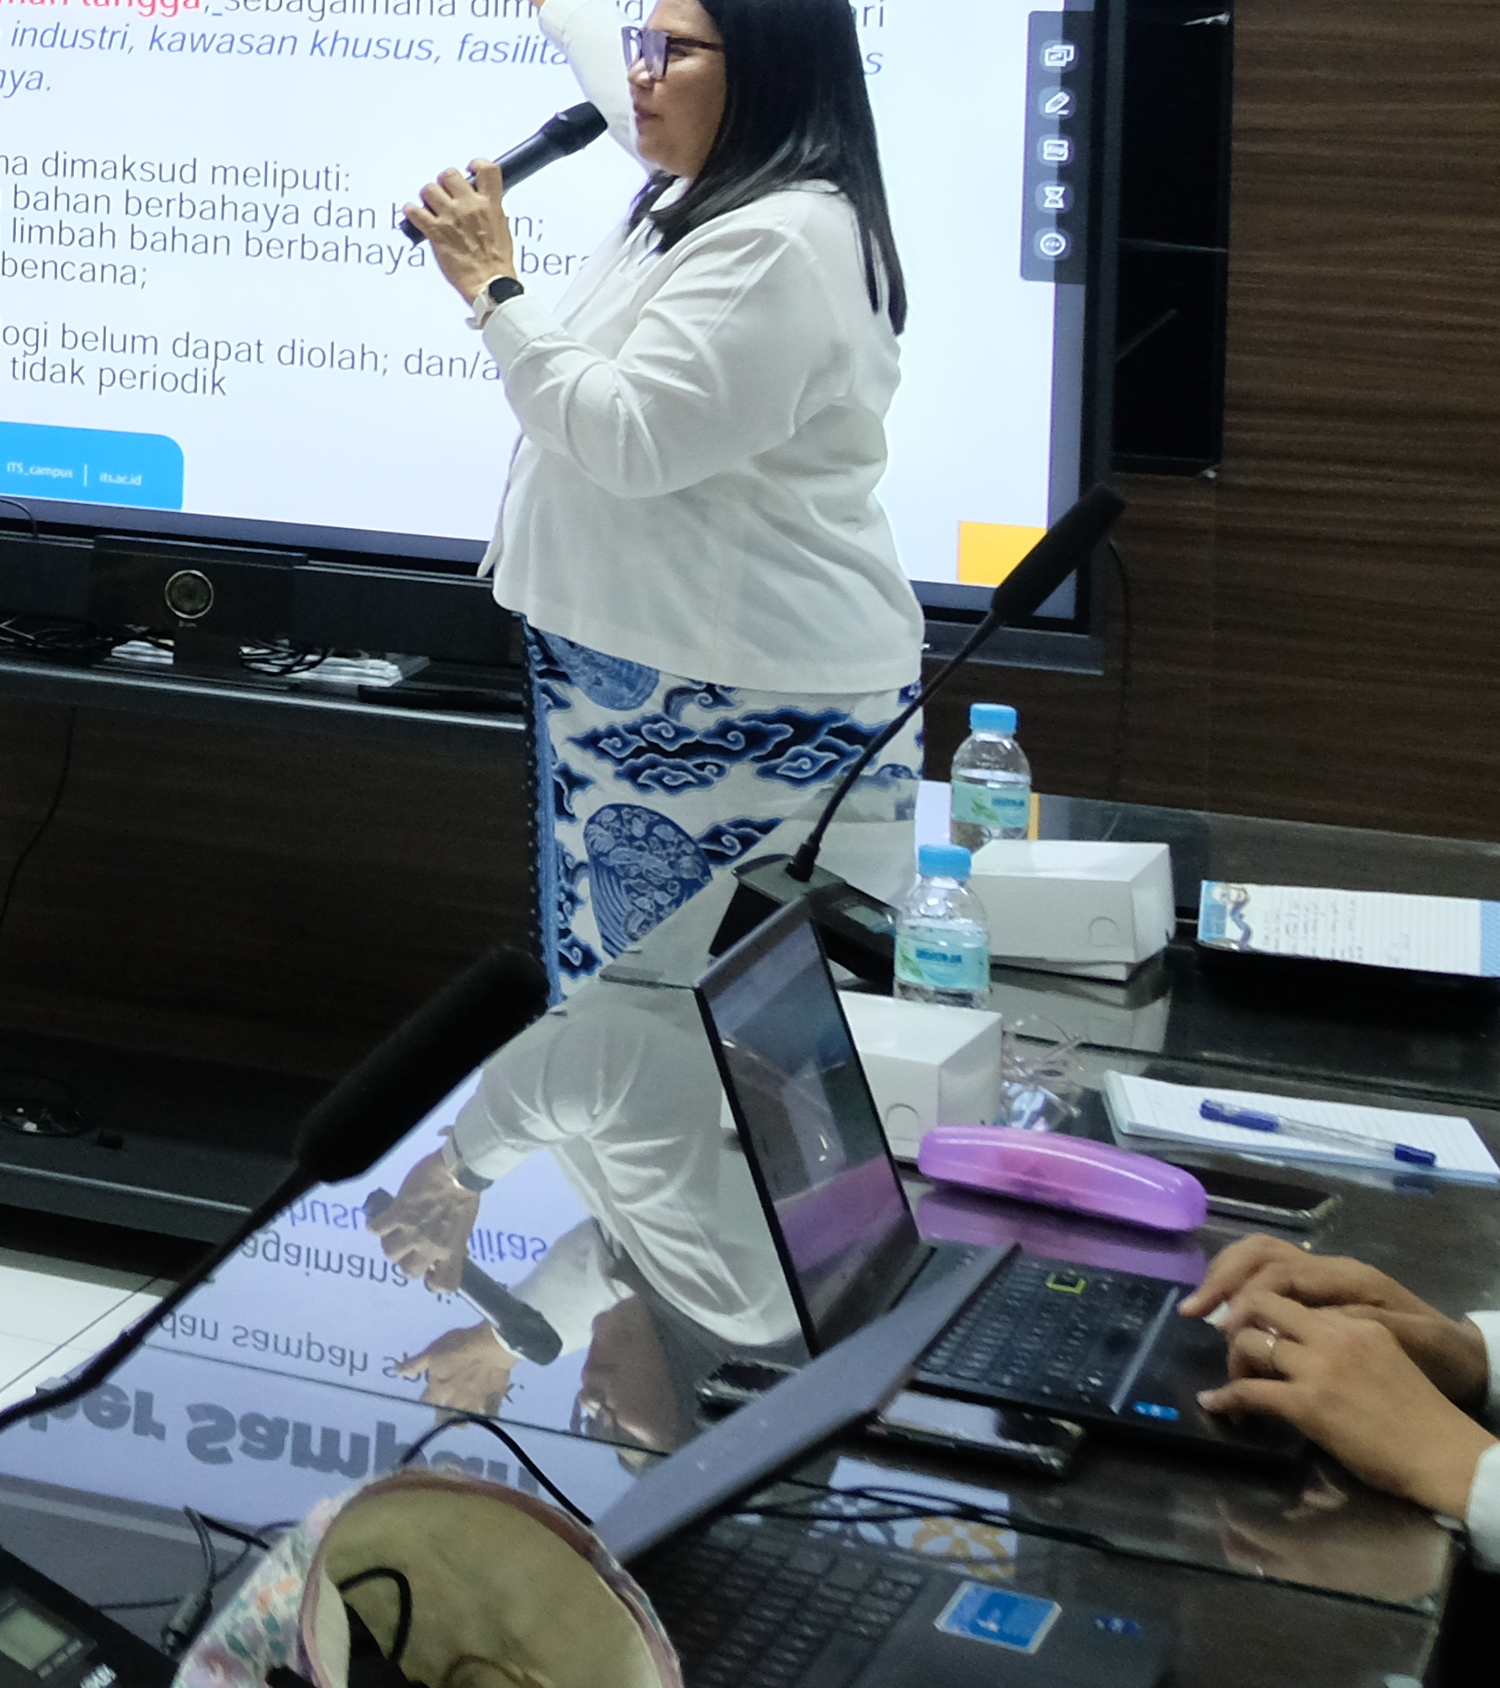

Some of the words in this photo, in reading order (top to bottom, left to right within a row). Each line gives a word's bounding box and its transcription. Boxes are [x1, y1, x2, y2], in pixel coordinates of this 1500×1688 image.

[10, 20, 134, 54] industri,
[148, 24, 297, 56] kawasan
[310, 29, 442, 63] khusus,
[456, 32, 568, 65] fasilita
[41, 151, 197, 184] dimaksud
[211, 161, 350, 198] meliputi:
[13, 183, 110, 214] bahan
[125, 189, 299, 233] berbahaya
[313, 199, 377, 229] dan
[2, 250, 148, 289] bencana;
[11, 217, 116, 249] limbah
[130, 223, 231, 256] bahan
[245, 230, 425, 275] berbahaya
[61, 323, 158, 355] belum
[172, 331, 265, 371] dapat
[278, 339, 389, 376] diolah;
[404, 347, 501, 381] dan/a
[10, 356, 85, 385] tidak
[98, 362, 227, 397] periodik
